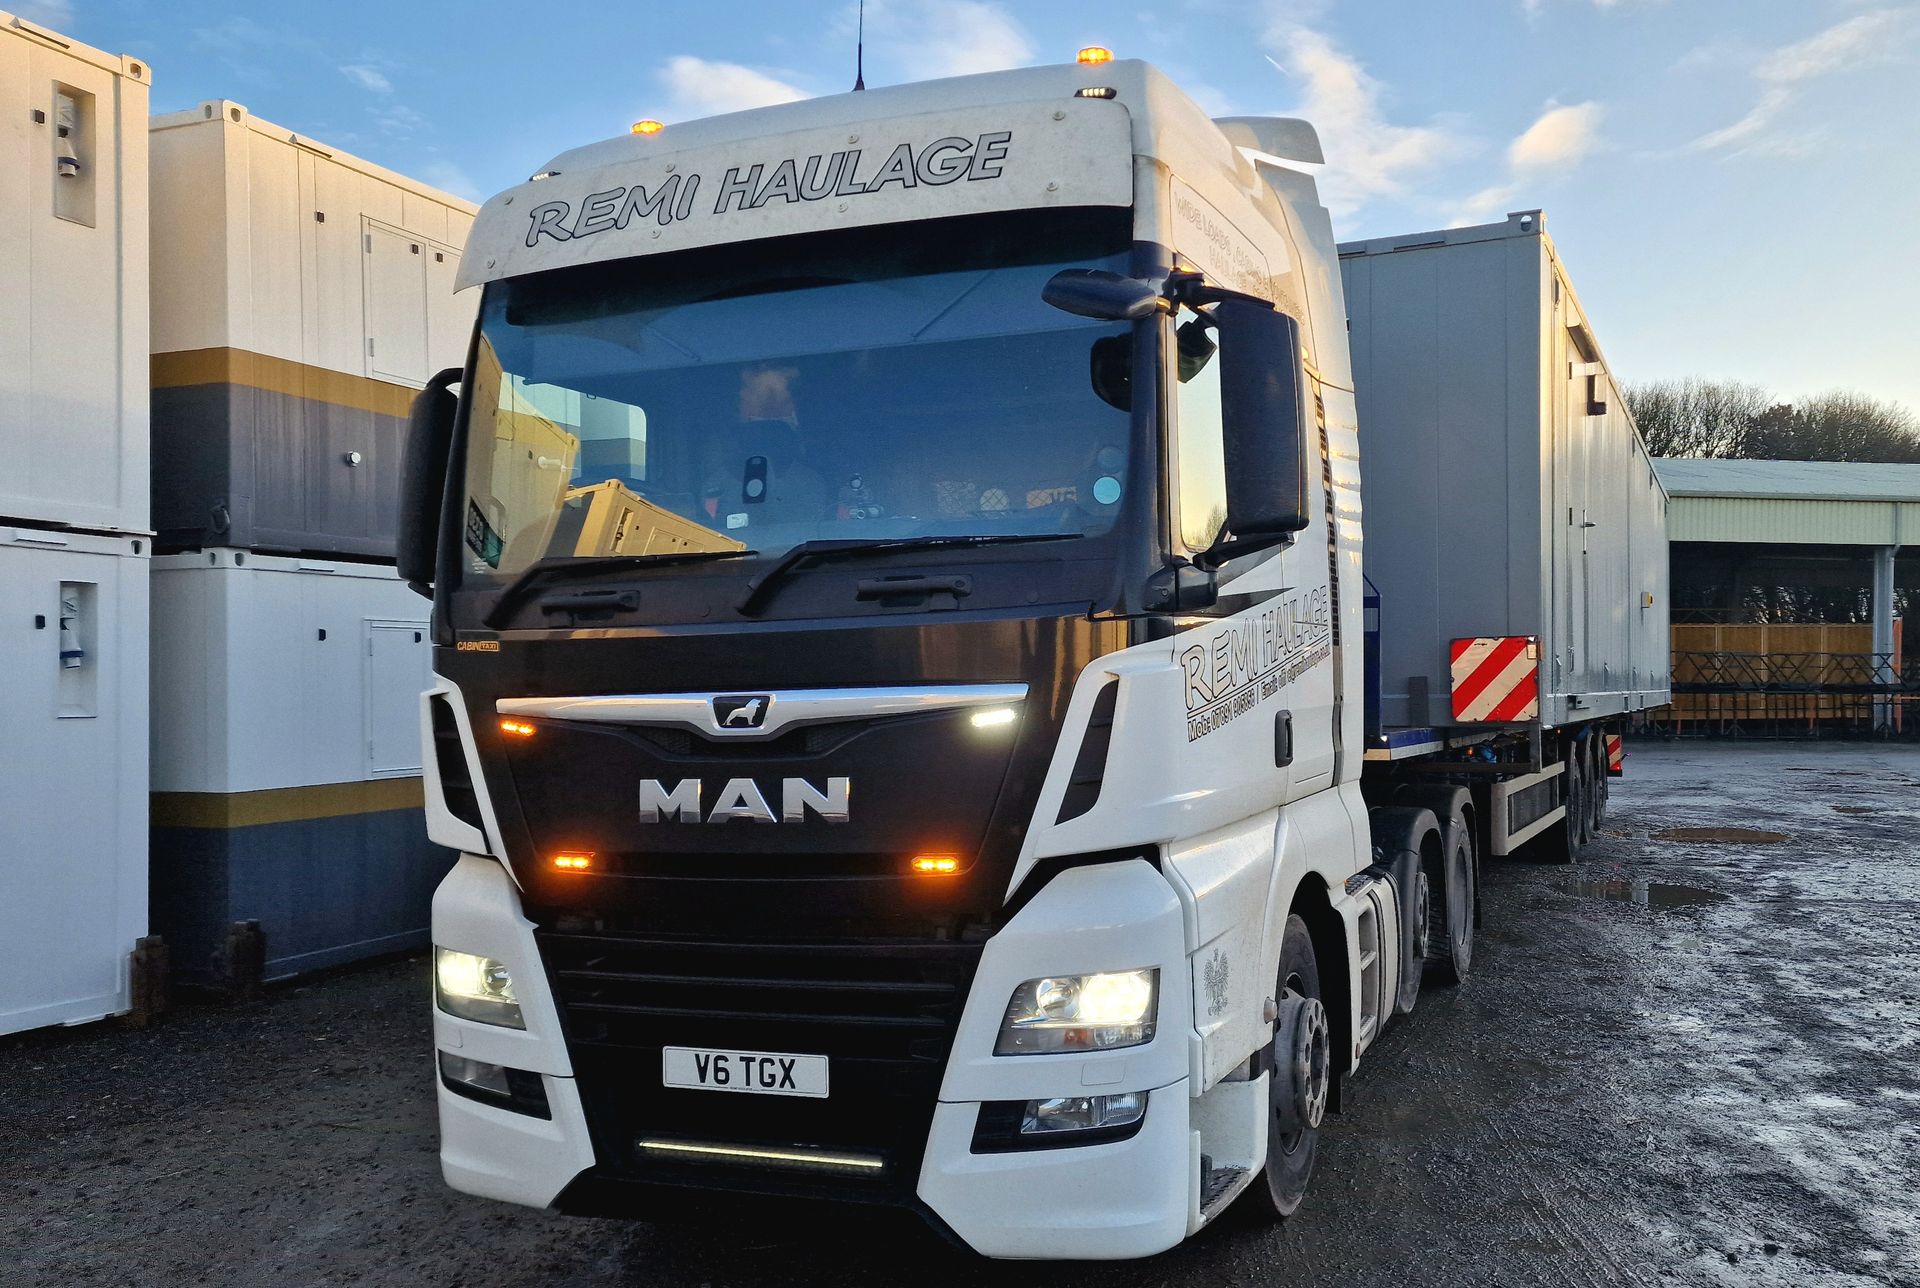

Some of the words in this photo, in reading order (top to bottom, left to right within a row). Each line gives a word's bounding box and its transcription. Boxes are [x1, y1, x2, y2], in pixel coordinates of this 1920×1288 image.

[525, 174, 701, 248] REMI
[713, 131, 1012, 215] HAULAGE
[1180, 618, 1258, 710] REMI
[1261, 585, 1329, 668] HAULAGE
[1187, 715, 1212, 743] Mob:
[639, 776, 850, 823] MAN
[694, 1053, 730, 1086] V6
[739, 1055, 796, 1090] TGX
